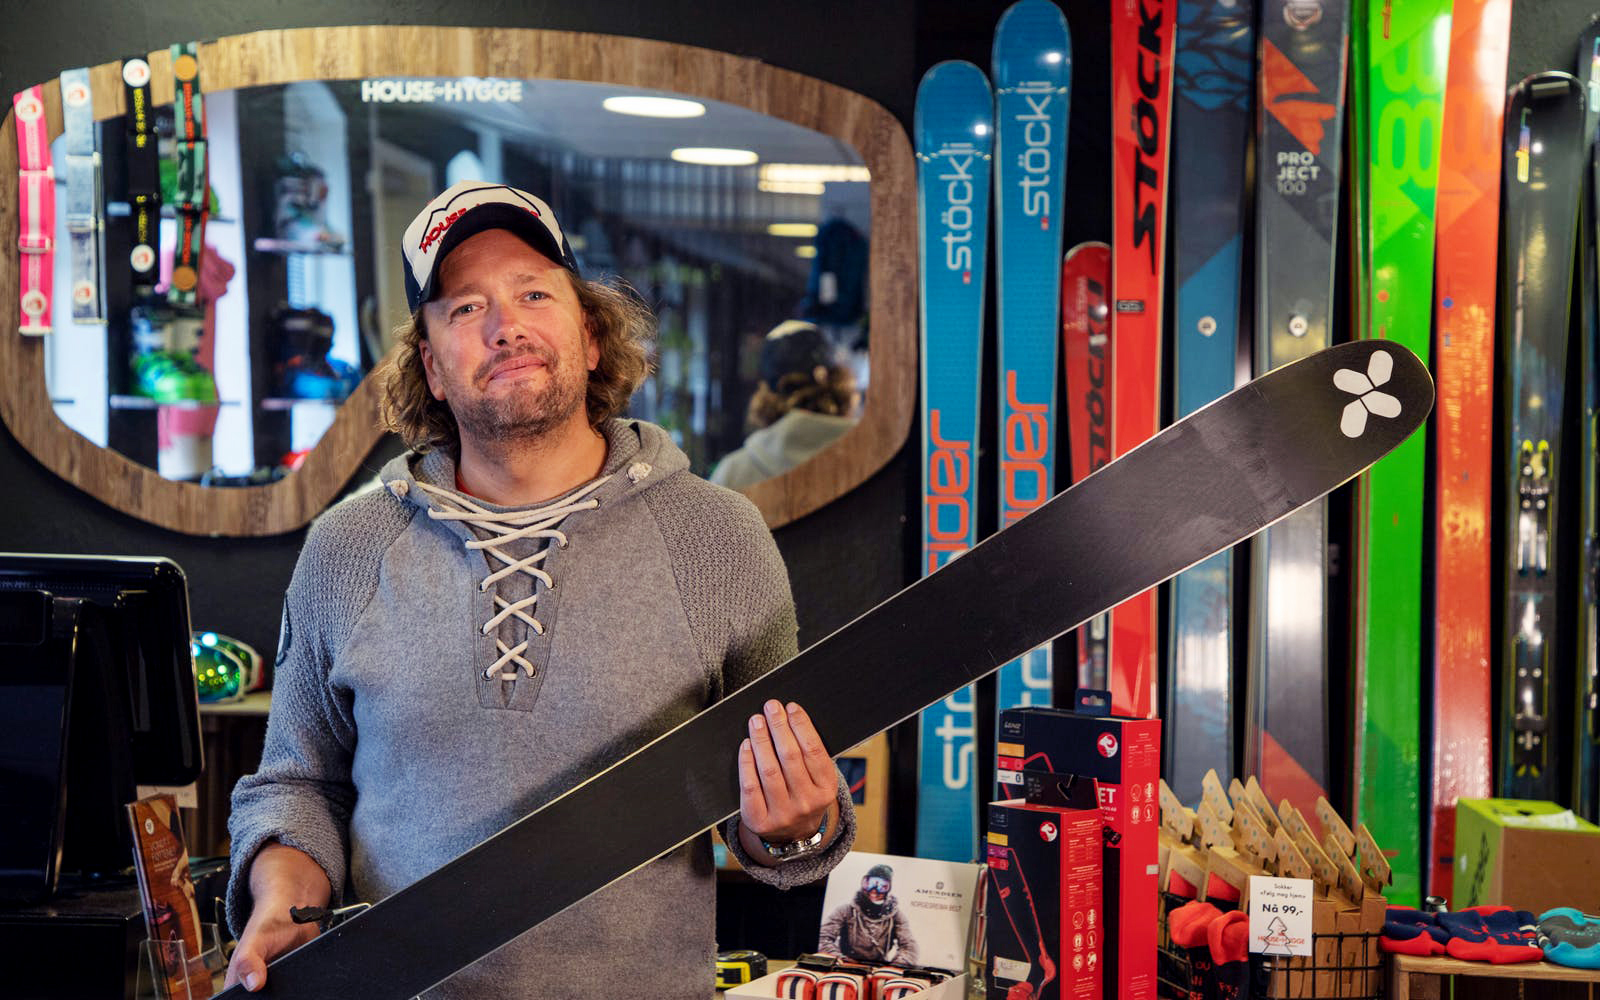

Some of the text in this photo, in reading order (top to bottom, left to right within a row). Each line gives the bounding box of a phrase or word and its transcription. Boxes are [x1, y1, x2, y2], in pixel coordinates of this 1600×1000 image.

[361, 80, 435, 102] HOUSE
[444, 80, 522, 102] HYGGE
[1131, 0, 1164, 276] STÖCK
[1015, 81, 1052, 217] stöckli
[1277, 152, 1314, 166] PRO
[1277, 166, 1321, 181] JECT
[1277, 181, 1307, 195] 100
[939, 142, 973, 270] stöckli
[1262, 902, 1279, 913] Nå
